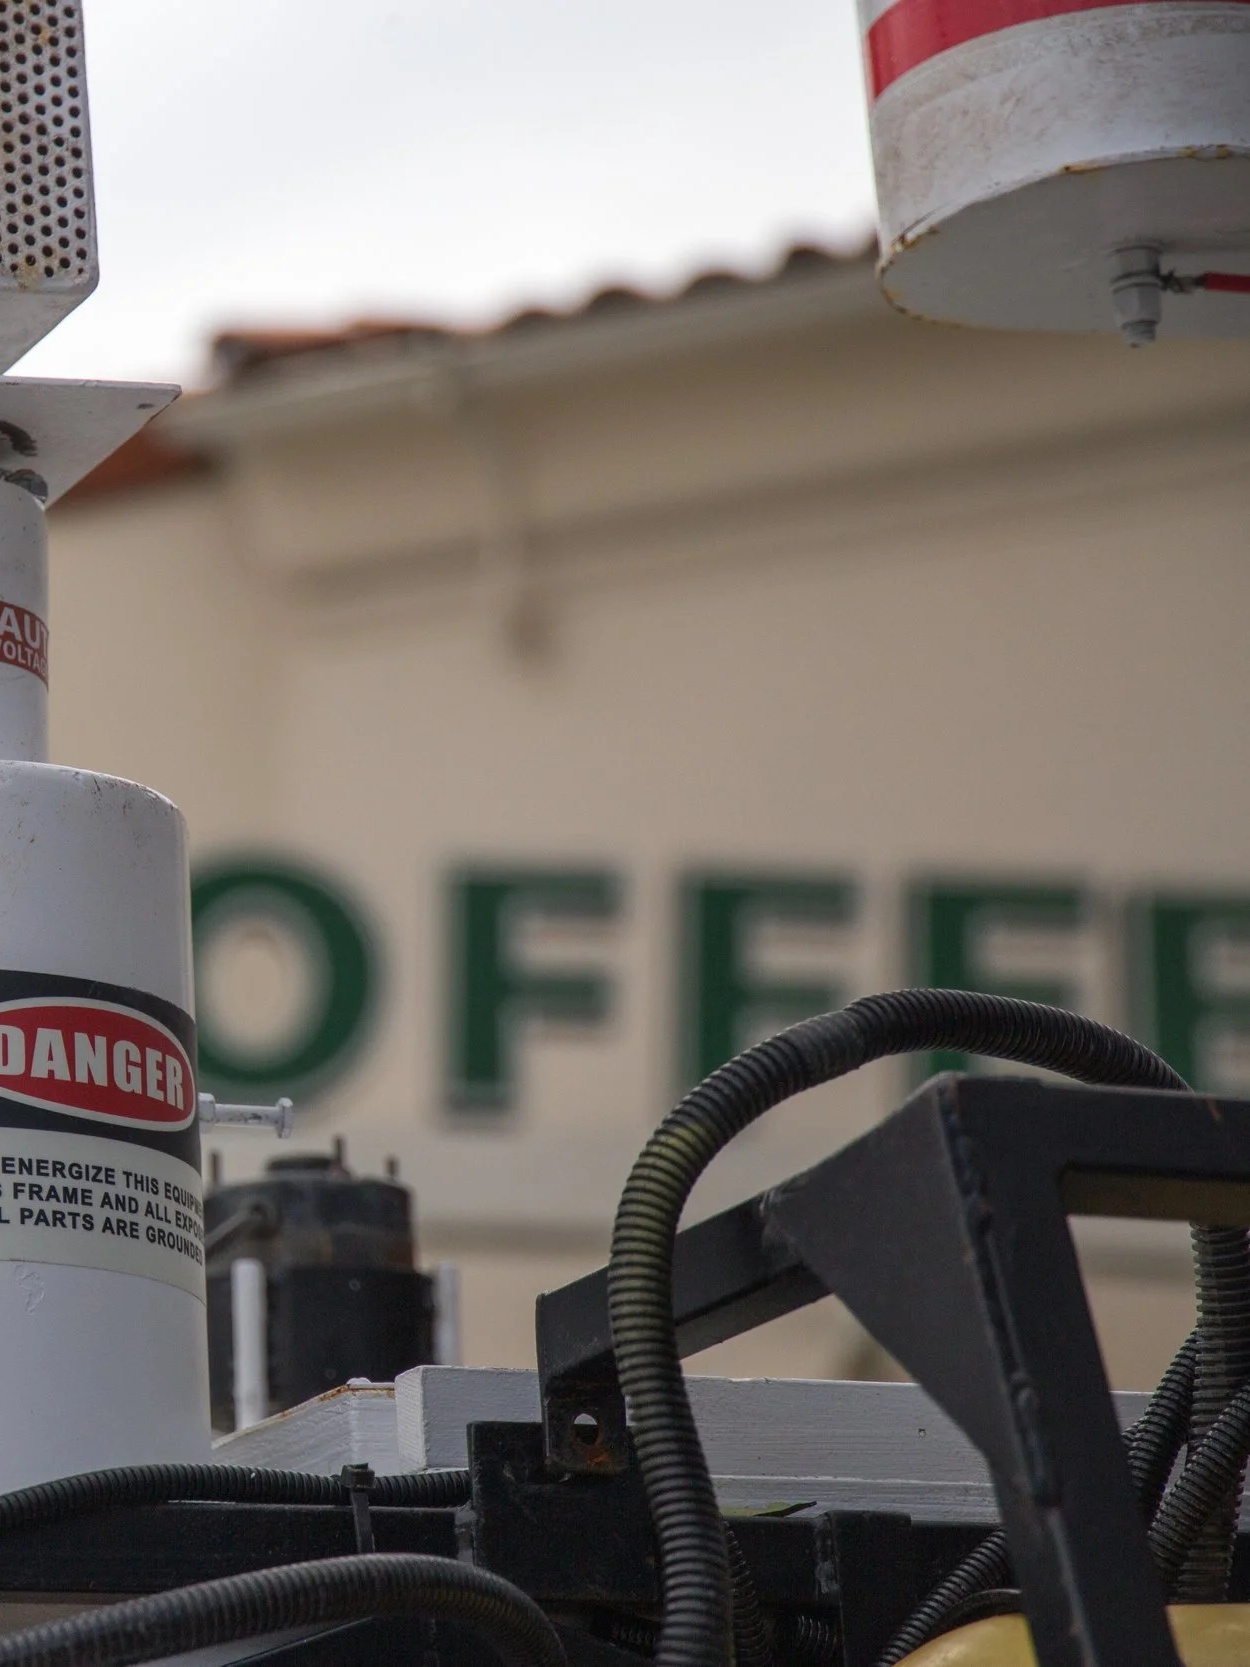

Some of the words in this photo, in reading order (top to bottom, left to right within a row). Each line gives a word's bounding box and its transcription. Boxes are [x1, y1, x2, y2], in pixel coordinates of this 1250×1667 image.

[1, 1157, 116, 1185] ENERGIZE
[122, 1171, 159, 1196] THIS
[13, 1182, 93, 1206] FRAME
[100, 1191, 139, 1214] AND
[144, 1201, 171, 1224] ALL
[20, 1207, 94, 1231] PARTS
[101, 1217, 140, 1239] ARE
